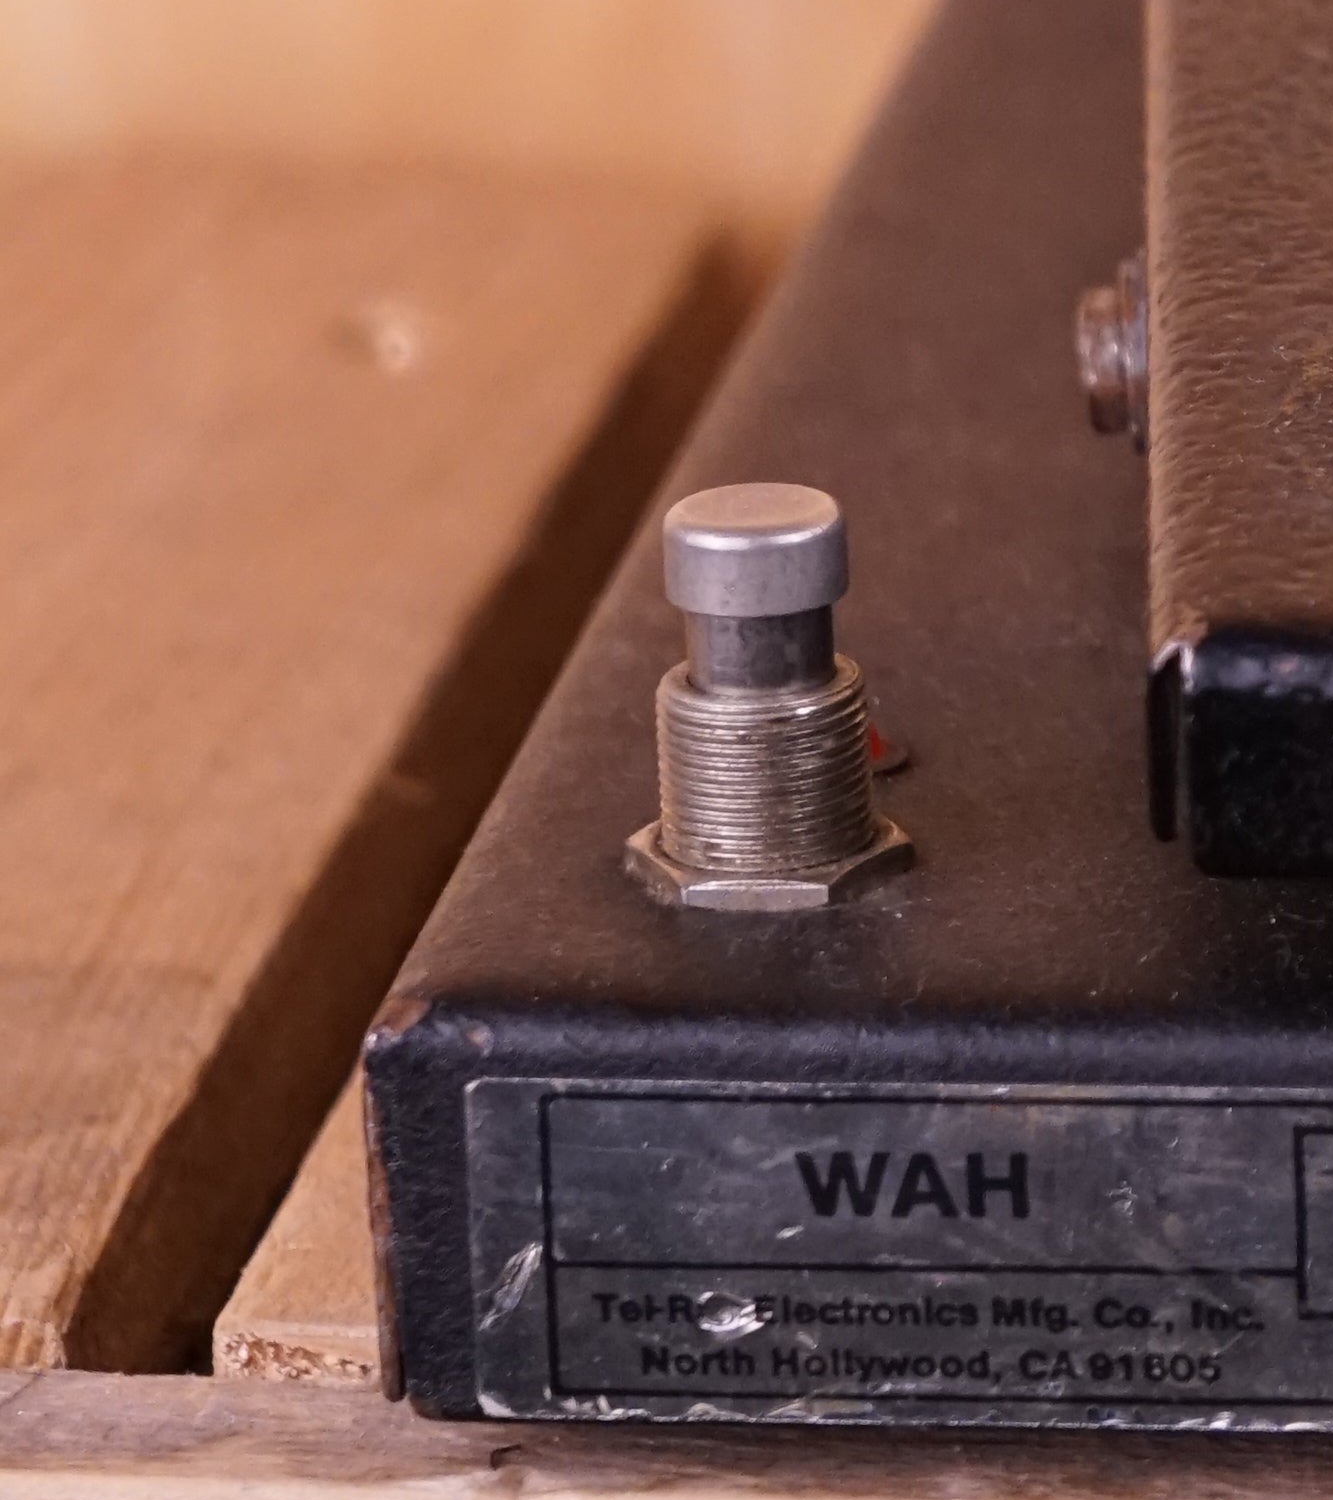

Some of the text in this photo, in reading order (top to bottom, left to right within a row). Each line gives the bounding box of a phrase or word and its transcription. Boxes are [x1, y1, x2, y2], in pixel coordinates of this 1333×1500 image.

[795, 1150, 1030, 1220] WAH
[592, 1293, 1265, 1334] Tel-R Electronics Mfg. Co., Inc.
[640, 1347, 755, 1376] North
[771, 1347, 1000, 1384] Hollywood,
[1019, 1350, 1077, 1380] CA
